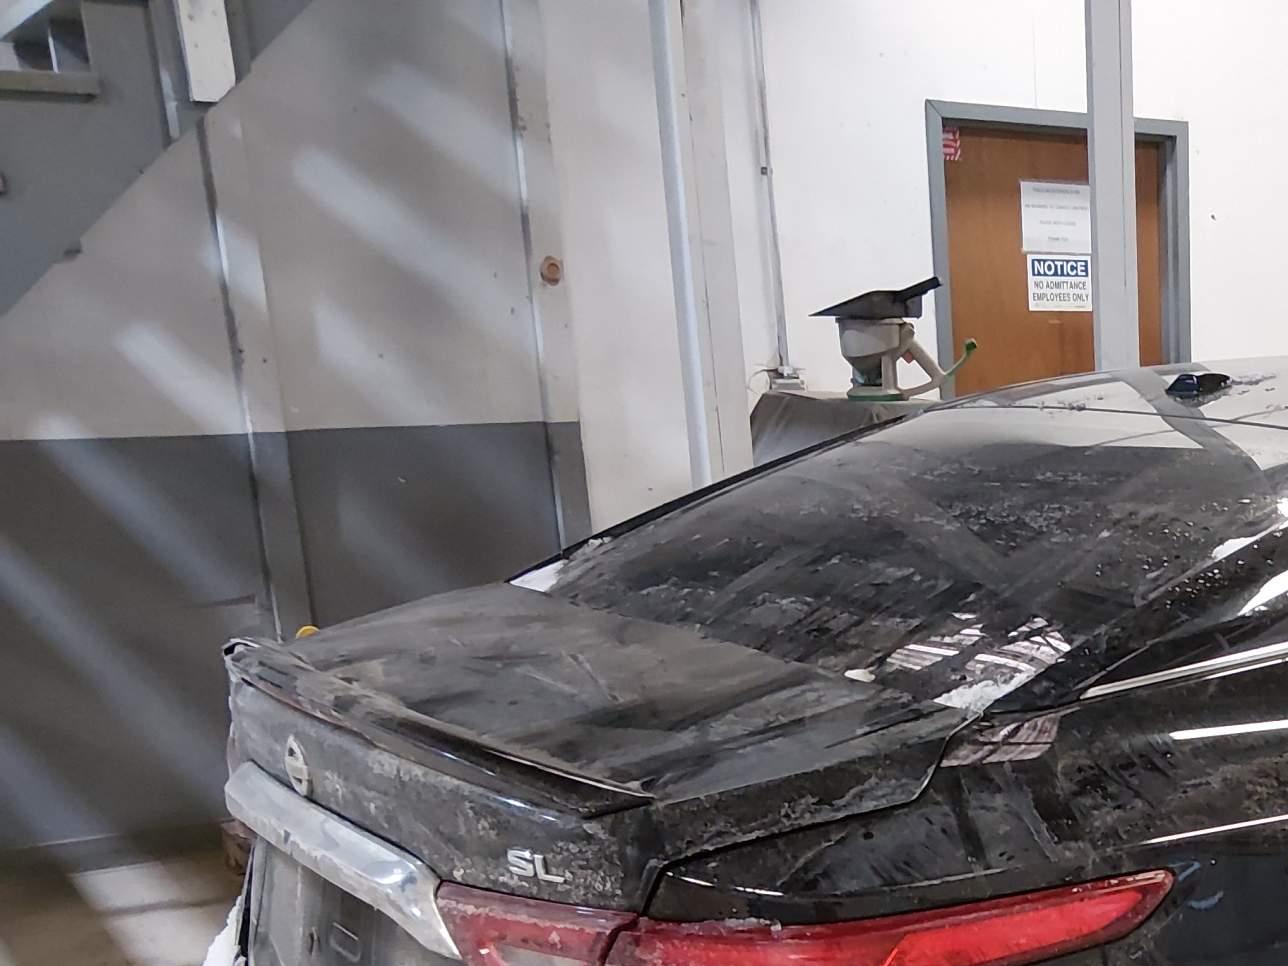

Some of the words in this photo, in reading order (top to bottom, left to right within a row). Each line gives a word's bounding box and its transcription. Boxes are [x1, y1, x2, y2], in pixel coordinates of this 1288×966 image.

[1034, 261, 1086, 275] NOTICE
[1033, 280, 1044, 290] NO
[1045, 280, 1087, 290] ADMITTANCE
[1032, 292, 1071, 302] EMPLOYEES
[1072, 293, 1089, 302] ONLY
[507, 849, 565, 883] SL
